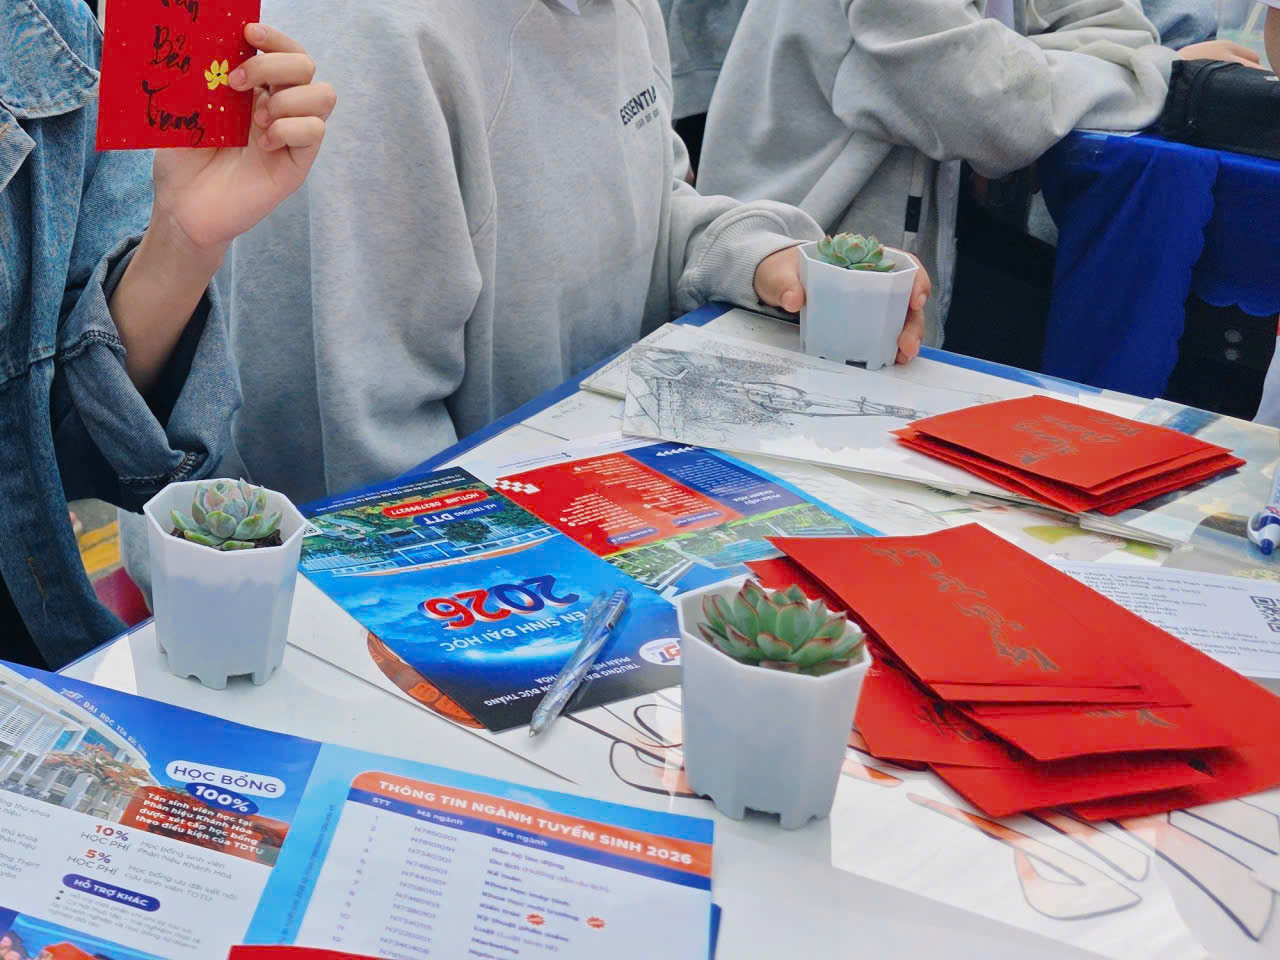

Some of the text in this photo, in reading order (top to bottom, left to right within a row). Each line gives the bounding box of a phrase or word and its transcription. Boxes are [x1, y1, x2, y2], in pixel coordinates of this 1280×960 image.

[444, 492, 480, 505] HOTLINE
[423, 512, 456, 526] DTT
[417, 574, 580, 631] 2026
[488, 627, 518, 644] ĐẠI
[516, 617, 561, 635] SINH
[439, 635, 483, 652] HỌC
[600, 663, 641, 677] TRƯỜNG
[483, 690, 520, 707] THẮNG
[173, 765, 278, 794] HỌC BỔNG
[147, 792, 253, 827] Tân sinh viên học tại
[195, 785, 249, 813] 100%
[139, 807, 259, 846] được xét cấp học bổng
[171, 807, 194, 819] hiệu
[195, 813, 229, 828] Khánh
[231, 823, 253, 835] Hòa
[372, 797, 548, 848] STT Mã ngành Tên ngành
[378, 780, 693, 866] THÔNG TIN NGÀNH TUYỂN SINH 2026
[80, 831, 131, 852] HỌC PHÍ
[95, 824, 129, 842] 10%
[135, 815, 264, 855] theo điều kiện của TDTU
[66, 855, 119, 876] HỌC PHÍ
[85, 848, 112, 864] 5%
[73, 878, 150, 907] HỖ TRỢ KHÁC
